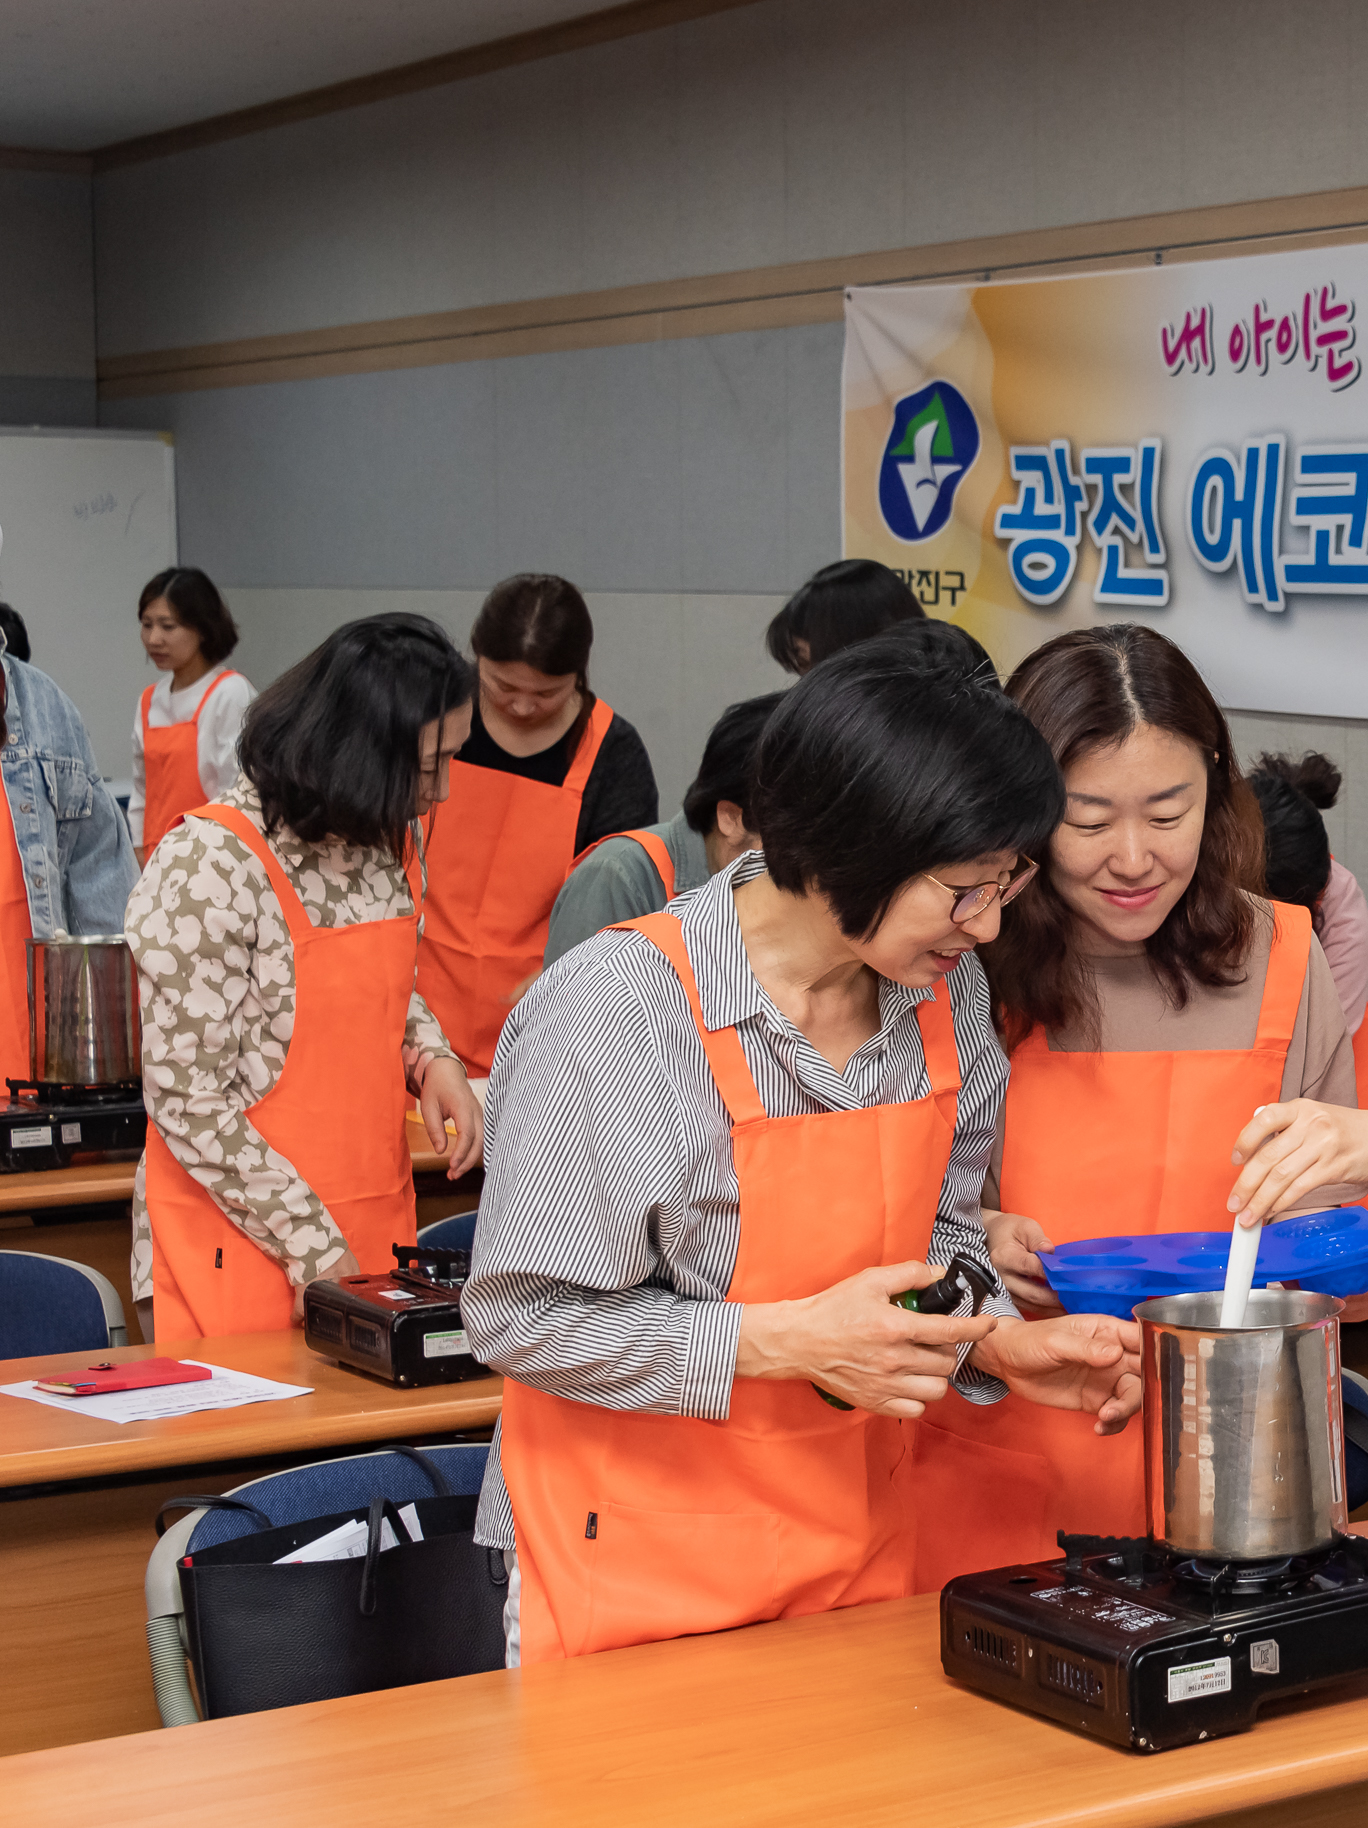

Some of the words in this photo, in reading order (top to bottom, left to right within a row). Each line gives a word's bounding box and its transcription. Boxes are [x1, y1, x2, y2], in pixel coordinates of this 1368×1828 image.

[1161, 308, 1214, 376] 내
[1227, 290, 1361, 391] 아이는
[997, 438, 1172, 606] 광진
